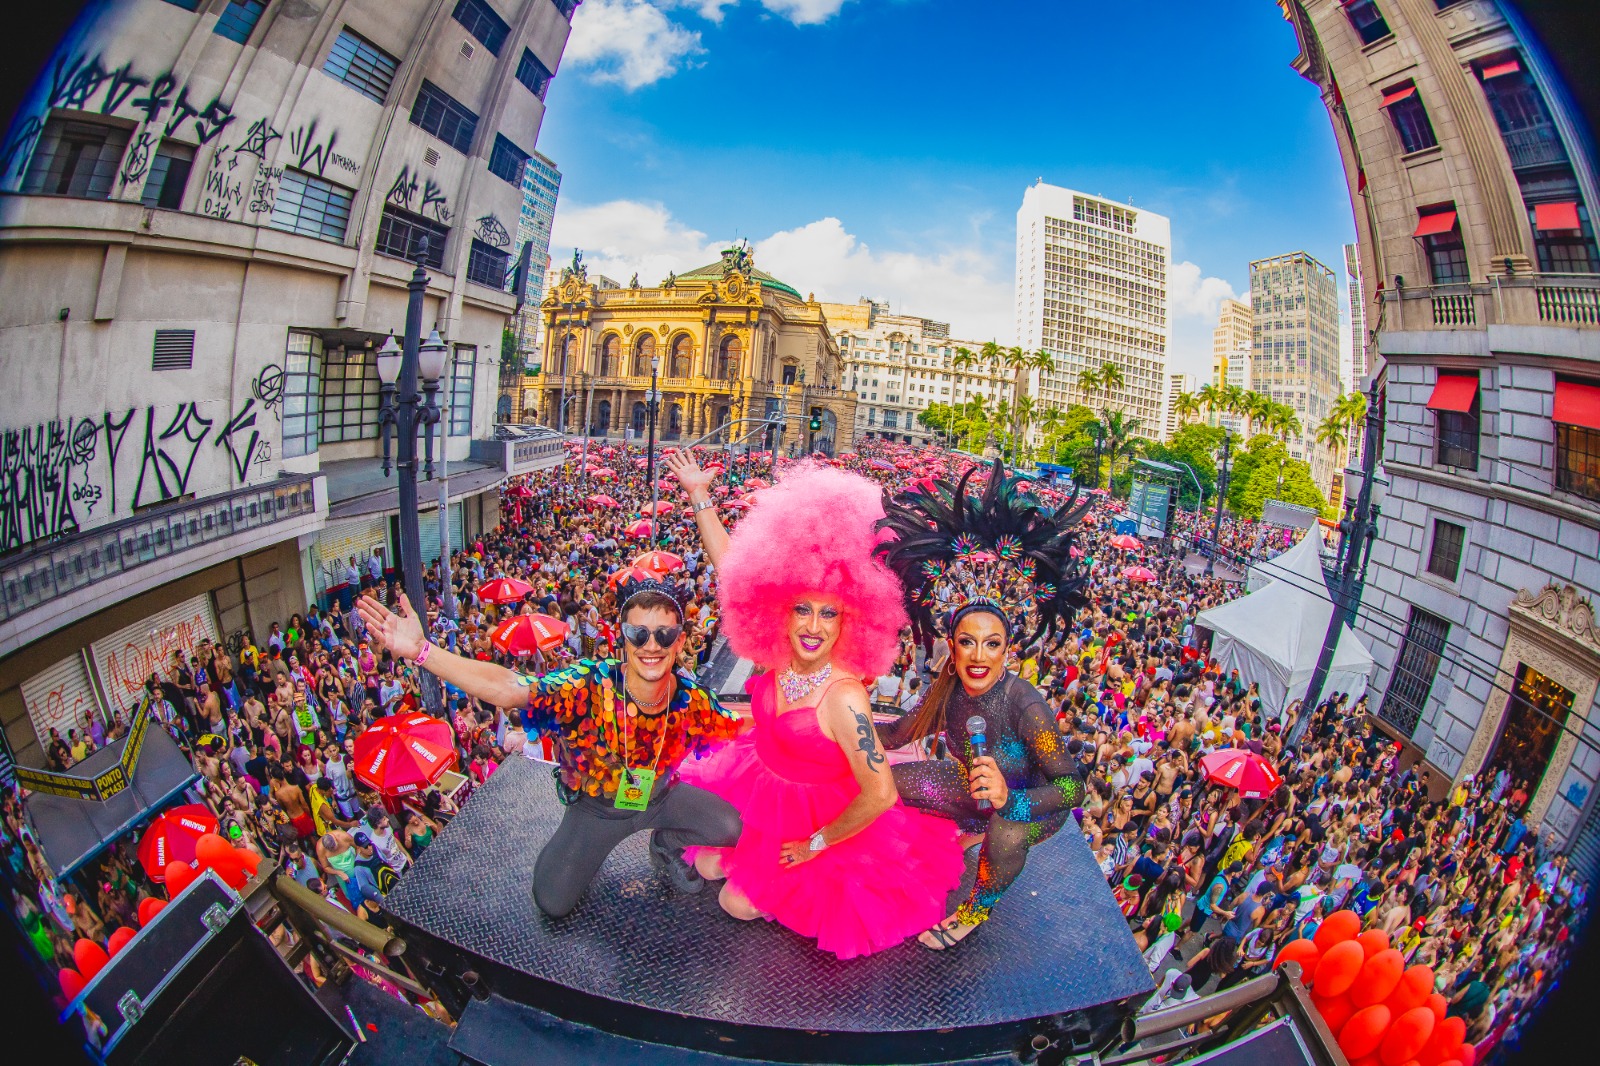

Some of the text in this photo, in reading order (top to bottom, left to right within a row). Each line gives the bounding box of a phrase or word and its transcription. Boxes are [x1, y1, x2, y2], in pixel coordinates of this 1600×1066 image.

[369, 748, 387, 775] BRAHMA
[411, 740, 438, 763] BRAHMA
[96, 767, 122, 790] PONTO
[181, 817, 206, 833] BRAHMA
[157, 836, 165, 867] BRAHMA
